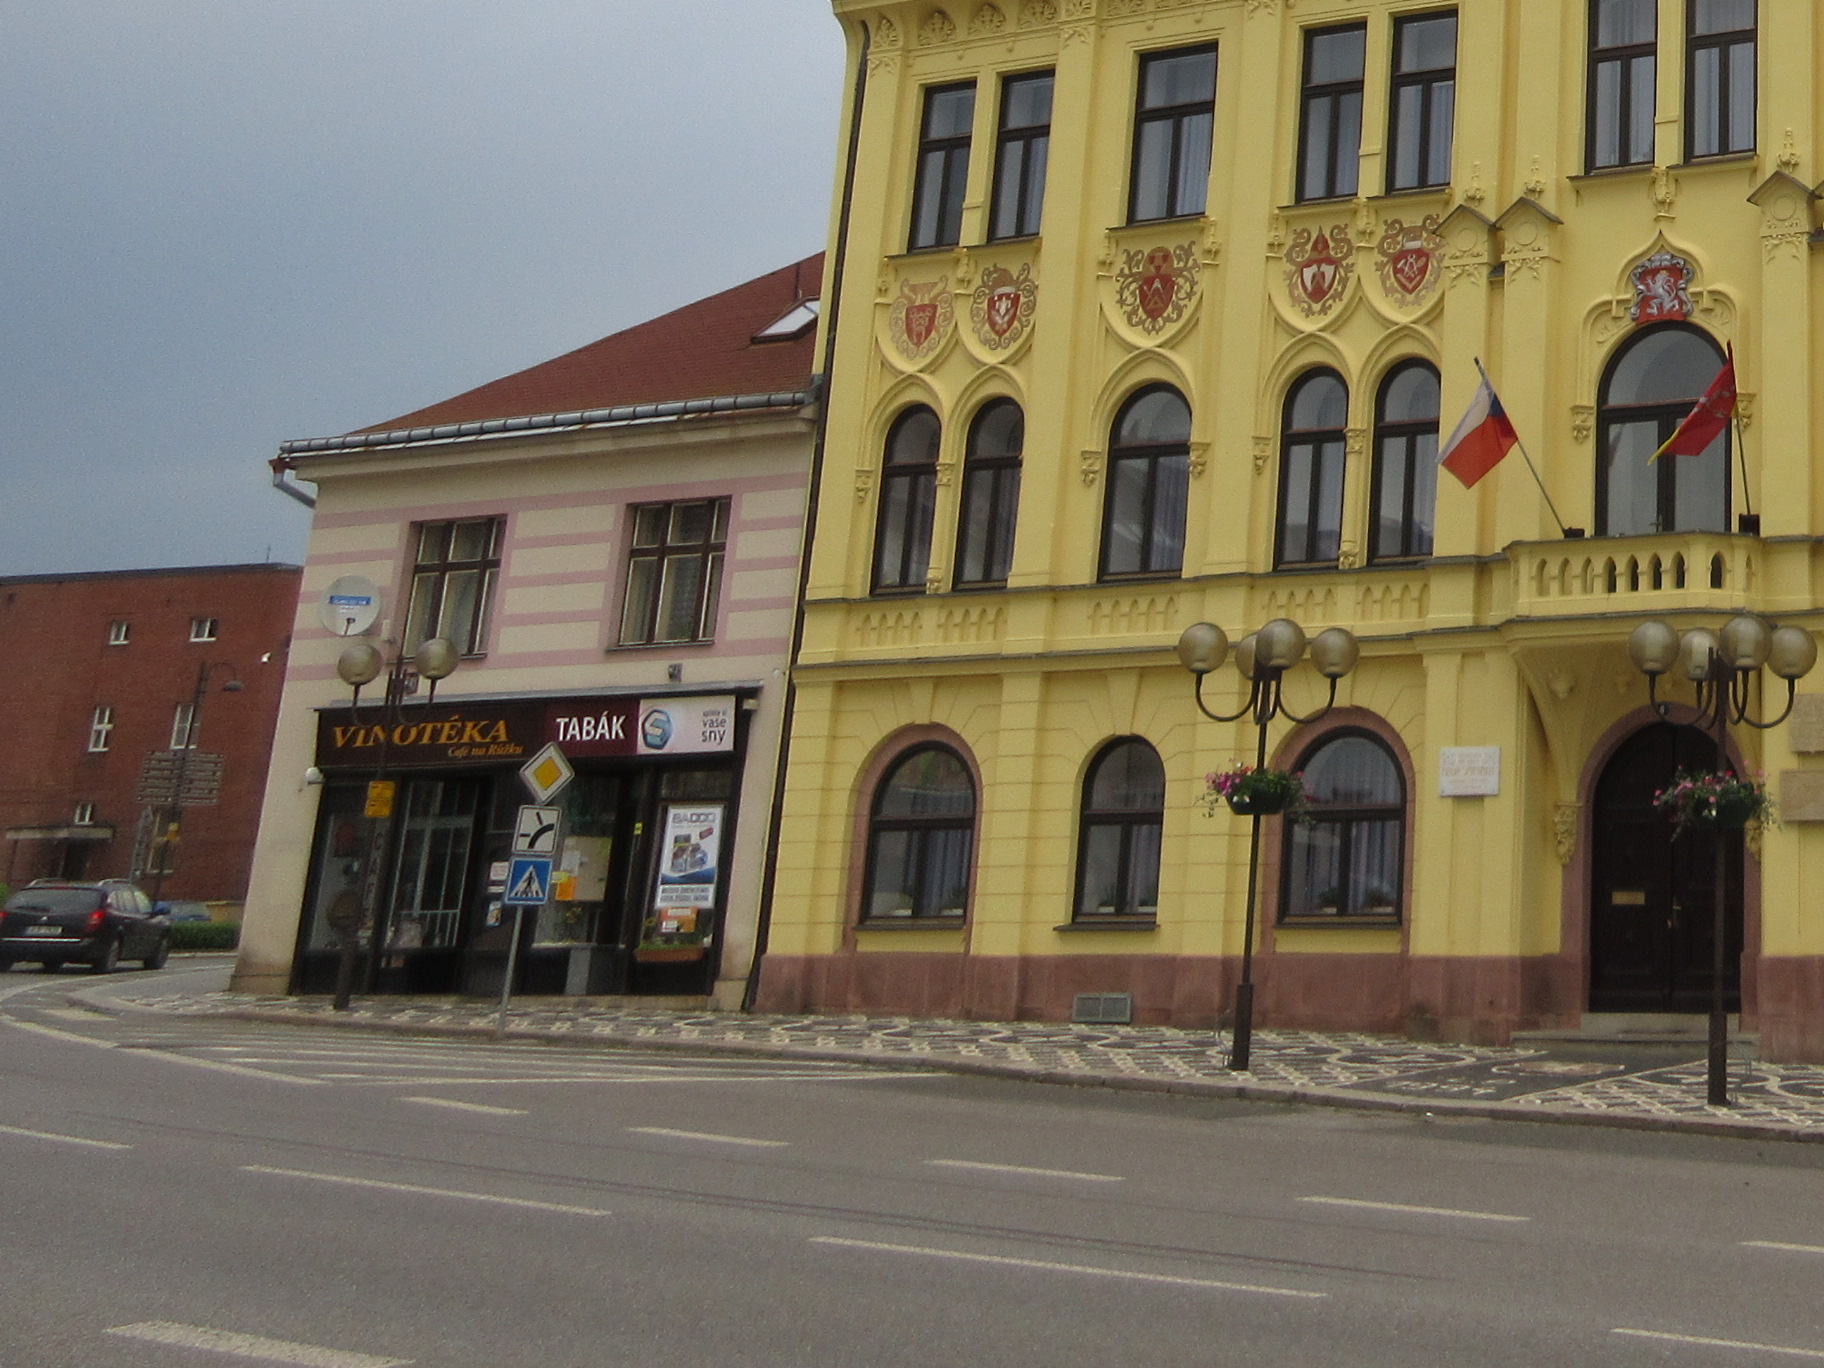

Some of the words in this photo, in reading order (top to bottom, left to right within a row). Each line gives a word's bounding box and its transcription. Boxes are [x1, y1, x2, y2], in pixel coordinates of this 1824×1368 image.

[333, 714, 510, 748] VINOTÉKA
[555, 710, 627, 742] TABÁK
[701, 728, 726, 745] sny
